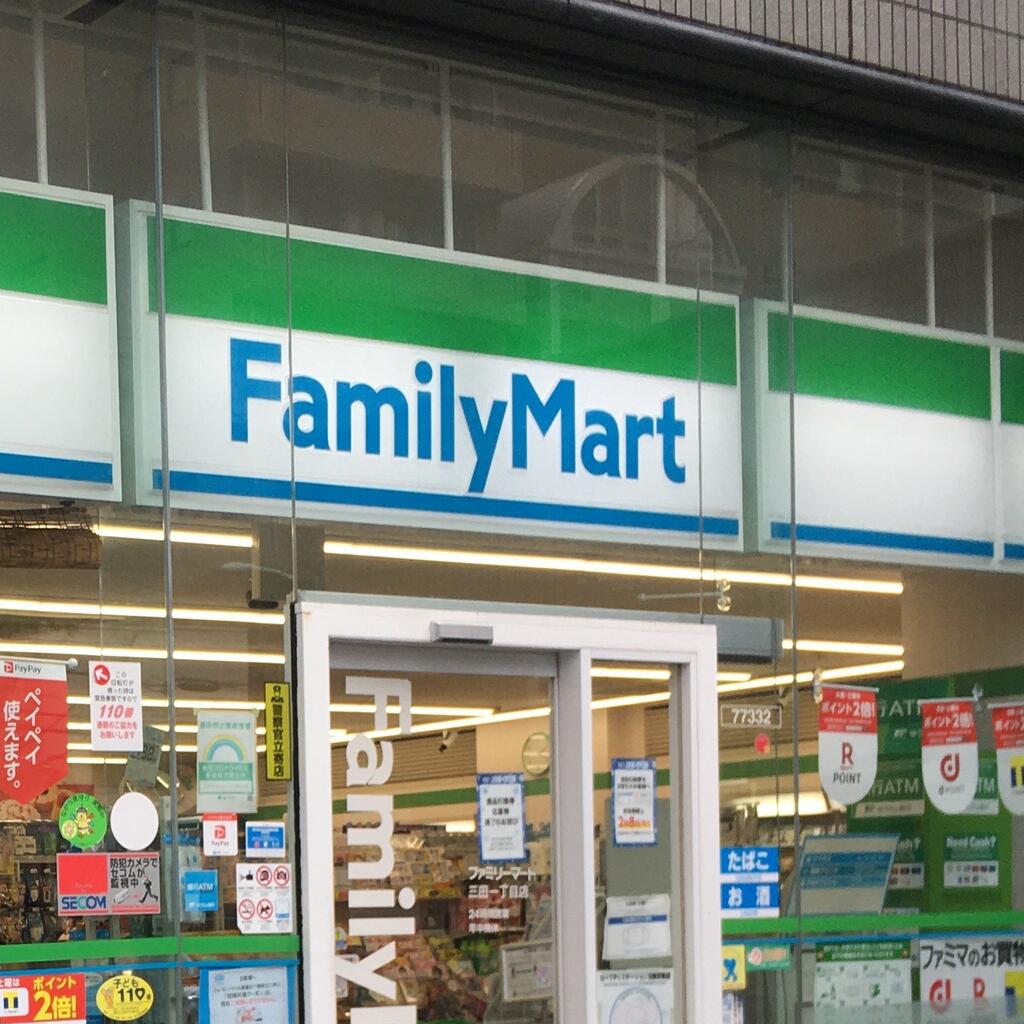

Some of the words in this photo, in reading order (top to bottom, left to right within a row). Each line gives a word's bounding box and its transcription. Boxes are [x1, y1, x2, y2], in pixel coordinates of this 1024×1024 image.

[230, 337, 686, 493] FamilyMart
[14, 664, 43, 674] PayPay
[731, 708, 772, 725] 77332
[24, 687, 42, 765] ペイペイ
[2, 700, 21, 789] 使えます。
[841, 742, 854, 766] R
[833, 772, 862, 785] POINT
[110, 858, 158, 868] 防犯カメラで
[728, 850, 770, 872] たばこ
[110, 868, 145, 878] セコムが
[468, 866, 537, 881] ファミリーマート
[110, 878, 139, 889] 監視中
[61, 895, 107, 909] SECOM
[33, 976, 77, 990] ポイント
[113, 977, 139, 989] 子ども
